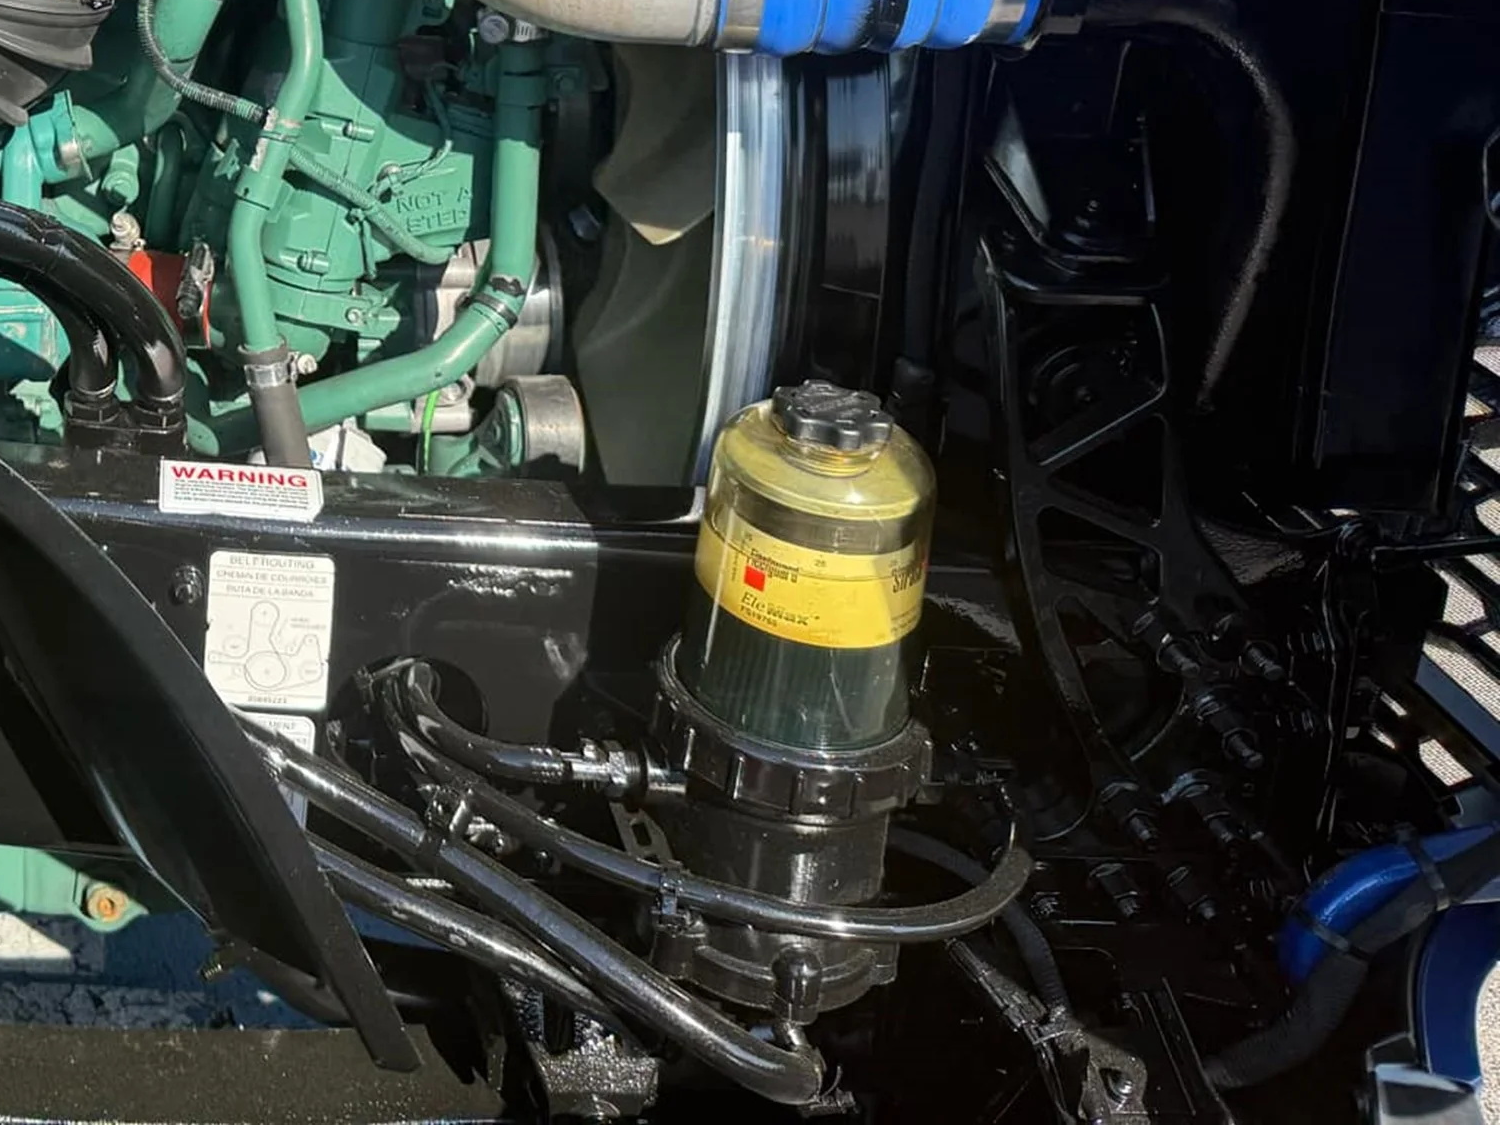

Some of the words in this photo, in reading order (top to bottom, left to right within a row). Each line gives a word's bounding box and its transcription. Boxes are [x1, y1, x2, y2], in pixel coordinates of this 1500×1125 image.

[396, 191, 441, 214] NOT
[456, 186, 470, 203] A
[407, 208, 467, 233] STEP
[171, 466, 308, 488] WARNING
[229, 555, 259, 566] BELT
[261, 557, 315, 569] ROUTING
